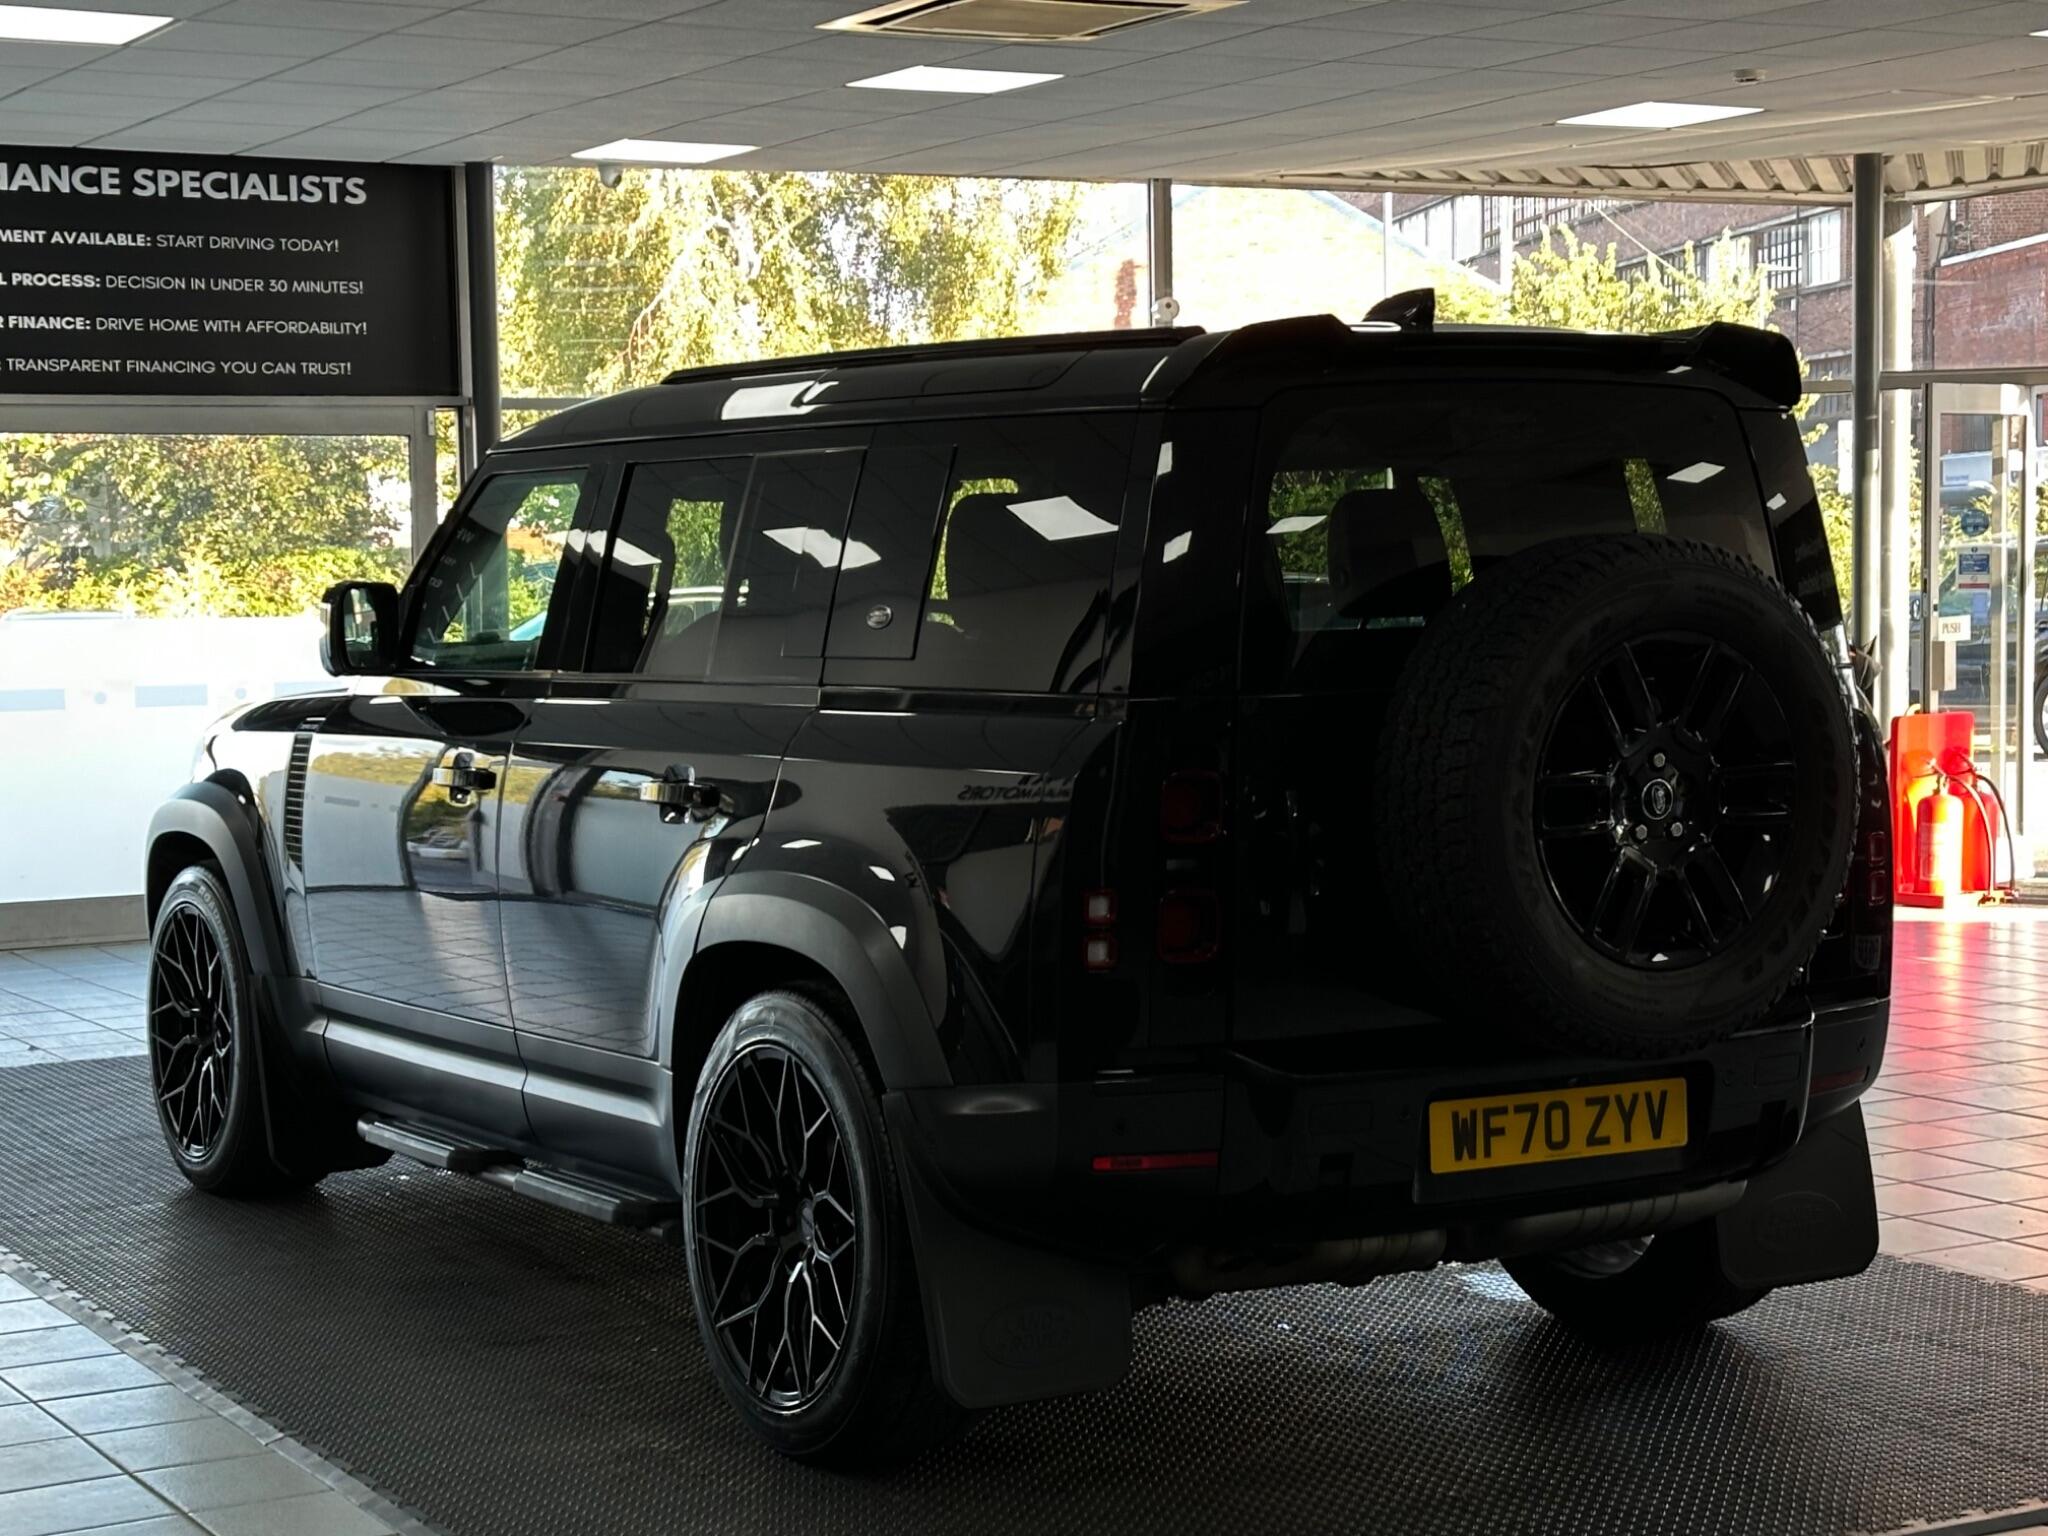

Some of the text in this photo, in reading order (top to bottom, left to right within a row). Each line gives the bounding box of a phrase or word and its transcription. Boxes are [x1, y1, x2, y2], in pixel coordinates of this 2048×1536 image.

[0, 163, 367, 205] ANCE SPECIALISTS
[50, 231, 152, 247] AVAILABLE:
[156, 234, 204, 249] START
[209, 236, 275, 251] DRIVING
[279, 238, 339, 253] TODAY!
[11, 272, 101, 288] PROCESS:
[105, 275, 186, 290] DECISION
[190, 277, 206, 291] IN
[210, 278, 265, 292] UNDER
[268, 279, 288, 293] 30
[291, 281, 364, 295] MINUTES!
[7, 315, 92, 331] FINANCE:
[95, 317, 145, 332] DRIVE
[148, 318, 199, 333] HOME
[202, 319, 241, 333] WITH
[245, 320, 368, 336] AFFORDABILITY!
[6, 358, 352, 376] TRANSPARENT FINANCING YOU CAN TRUST!
[1942, 622, 1961, 634] PUSH
[1452, 1089, 1668, 1162] WF70 ZYV
